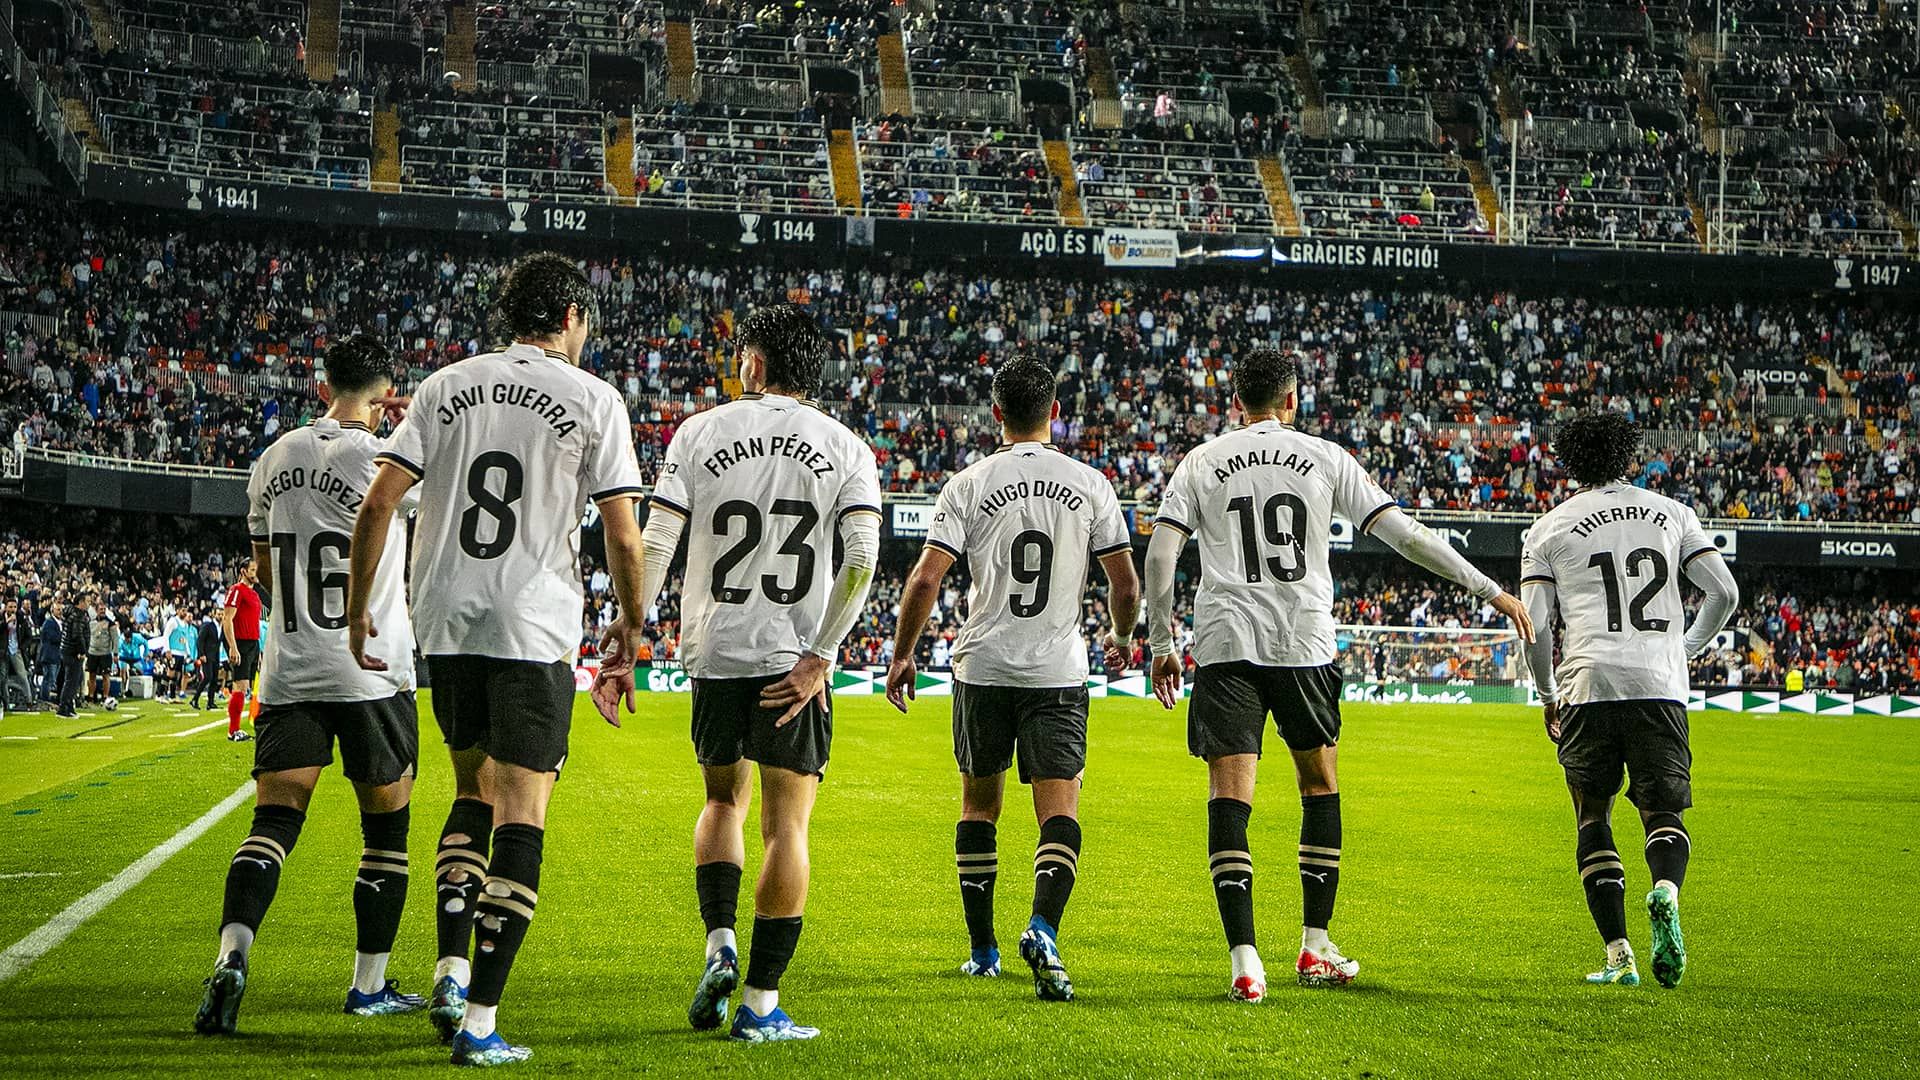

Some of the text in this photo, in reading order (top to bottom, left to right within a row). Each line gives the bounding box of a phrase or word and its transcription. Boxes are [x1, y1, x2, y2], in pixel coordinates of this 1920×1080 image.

[216, 186, 258, 210] 1941
[543, 208, 586, 230] 1942
[772, 220, 815, 242] 1944
[1063, 229, 1086, 254] ÉS
[1290, 240, 1439, 269] GRÀCIES AFICIÓ!
[1861, 264, 1900, 286] 1947
[437, 383, 578, 439] JAVI GUERRA
[703, 433, 835, 480] FRAN PÉREZ
[1214, 449, 1315, 484] AMALLAH
[310, 467, 365, 514] LÓPEZ
[459, 450, 524, 560] 8
[979, 480, 1083, 518] HUGO DURO
[899, 512, 919, 524] TM
[1570, 506, 1668, 539] THIERRY R.
[710, 498, 820, 605] 23
[1226, 492, 1308, 584] 19
[271, 530, 351, 633] 16
[1008, 529, 1054, 619] 9
[1587, 547, 1671, 633] 12
